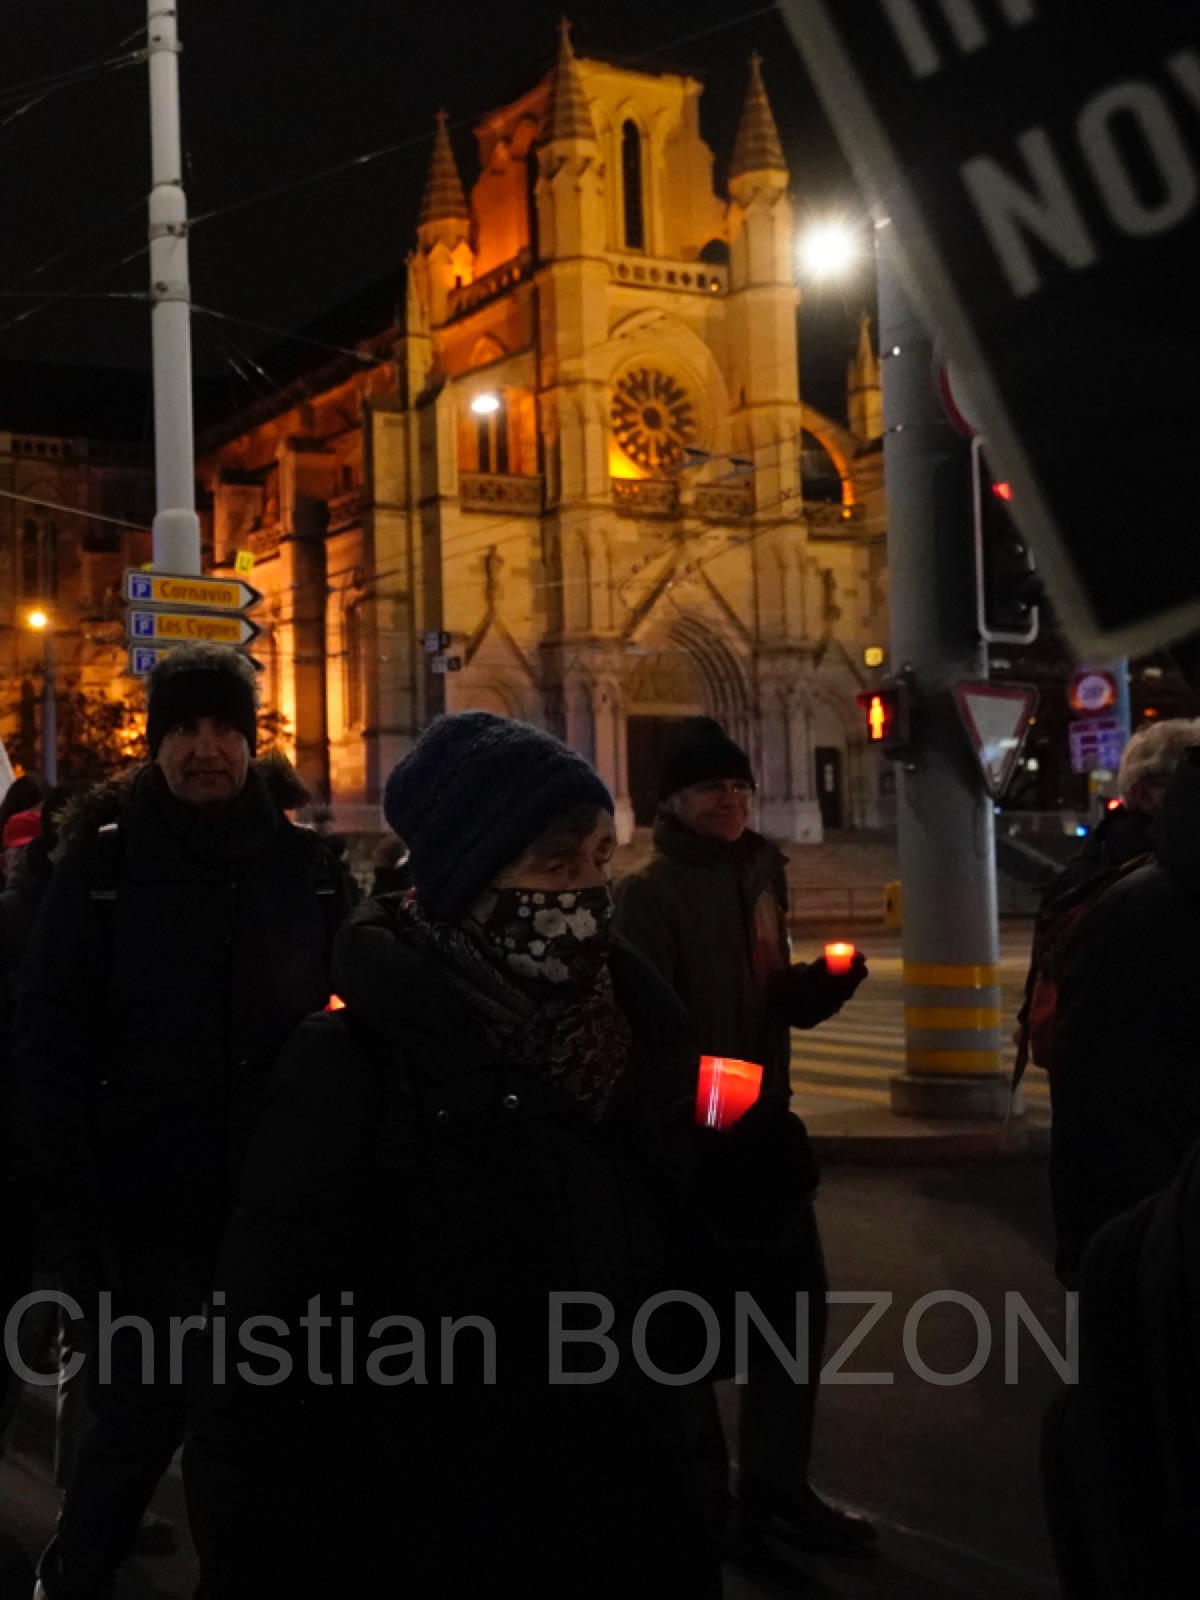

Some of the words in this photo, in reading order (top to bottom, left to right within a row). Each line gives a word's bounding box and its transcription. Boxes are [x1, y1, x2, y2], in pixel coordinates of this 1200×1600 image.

[160, 580, 232, 601] Cornavin
[157, 616, 181, 634] Les
[187, 619, 239, 639] Cygnes
